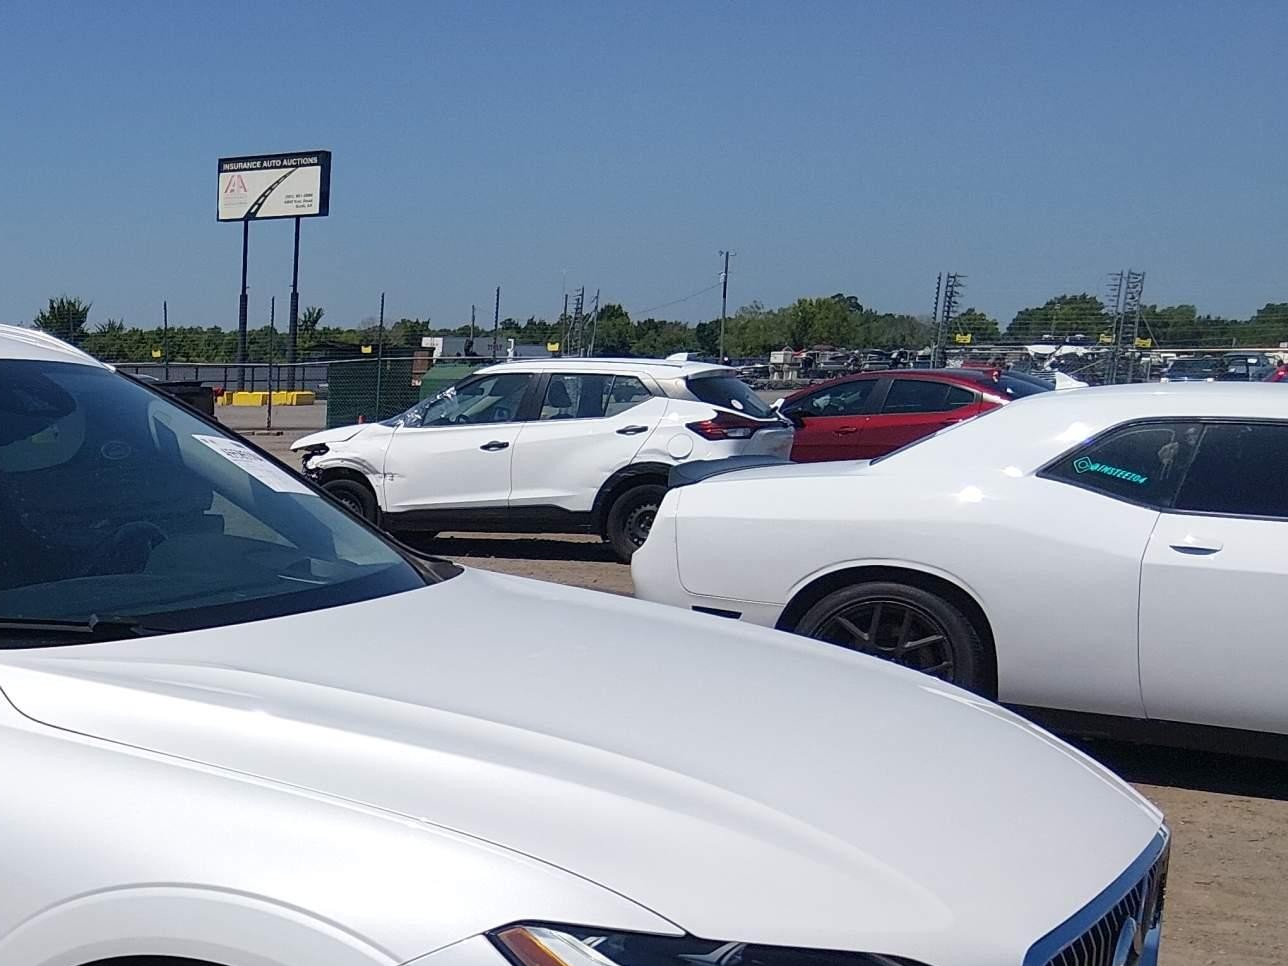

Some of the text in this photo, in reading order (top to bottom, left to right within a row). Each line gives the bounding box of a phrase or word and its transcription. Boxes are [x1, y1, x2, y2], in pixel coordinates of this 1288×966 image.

[223, 156, 318, 171] INSURANCE AUTO AUCTIONS
